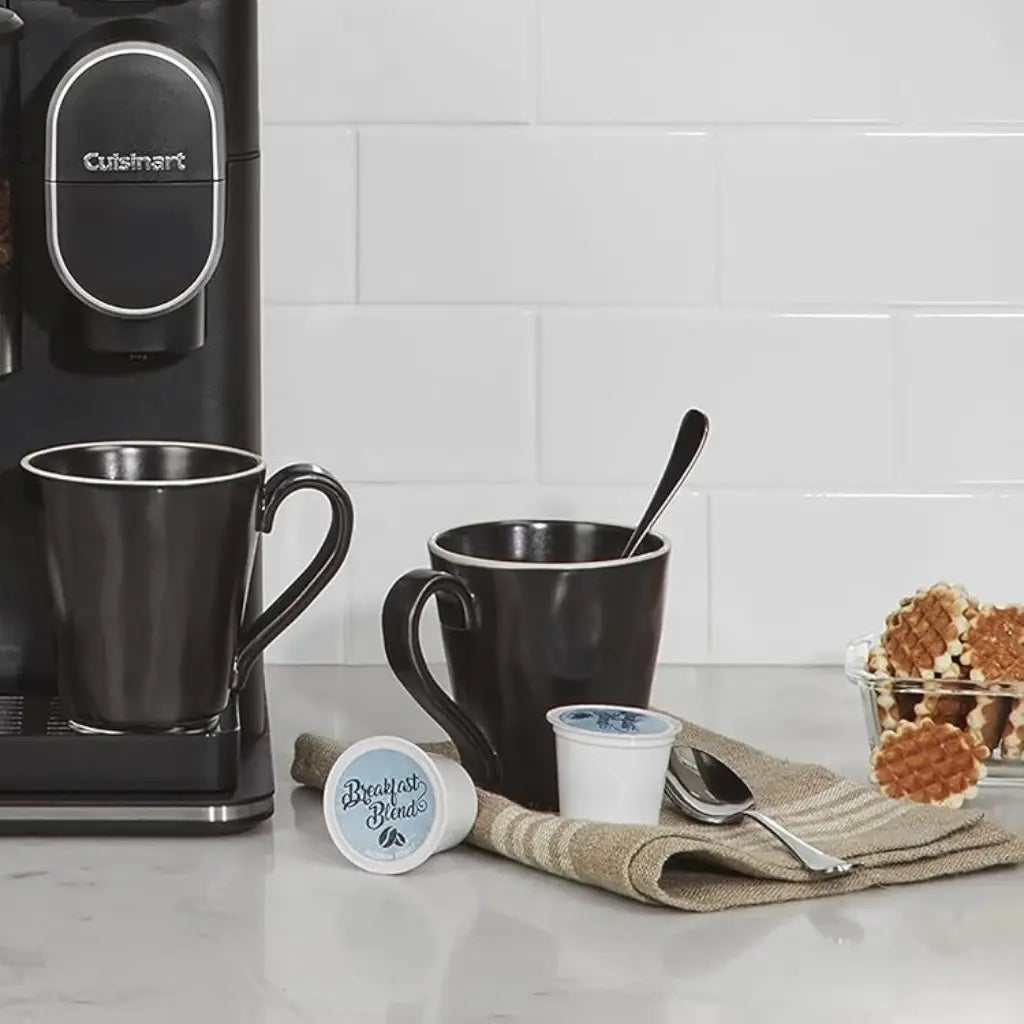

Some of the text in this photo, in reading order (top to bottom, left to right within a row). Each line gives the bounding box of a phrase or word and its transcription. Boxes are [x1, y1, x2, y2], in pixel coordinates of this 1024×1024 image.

[83, 152, 186, 171] Cuisinart
[341, 773, 428, 811] Breakfast
[366, 800, 428, 831] Blend
